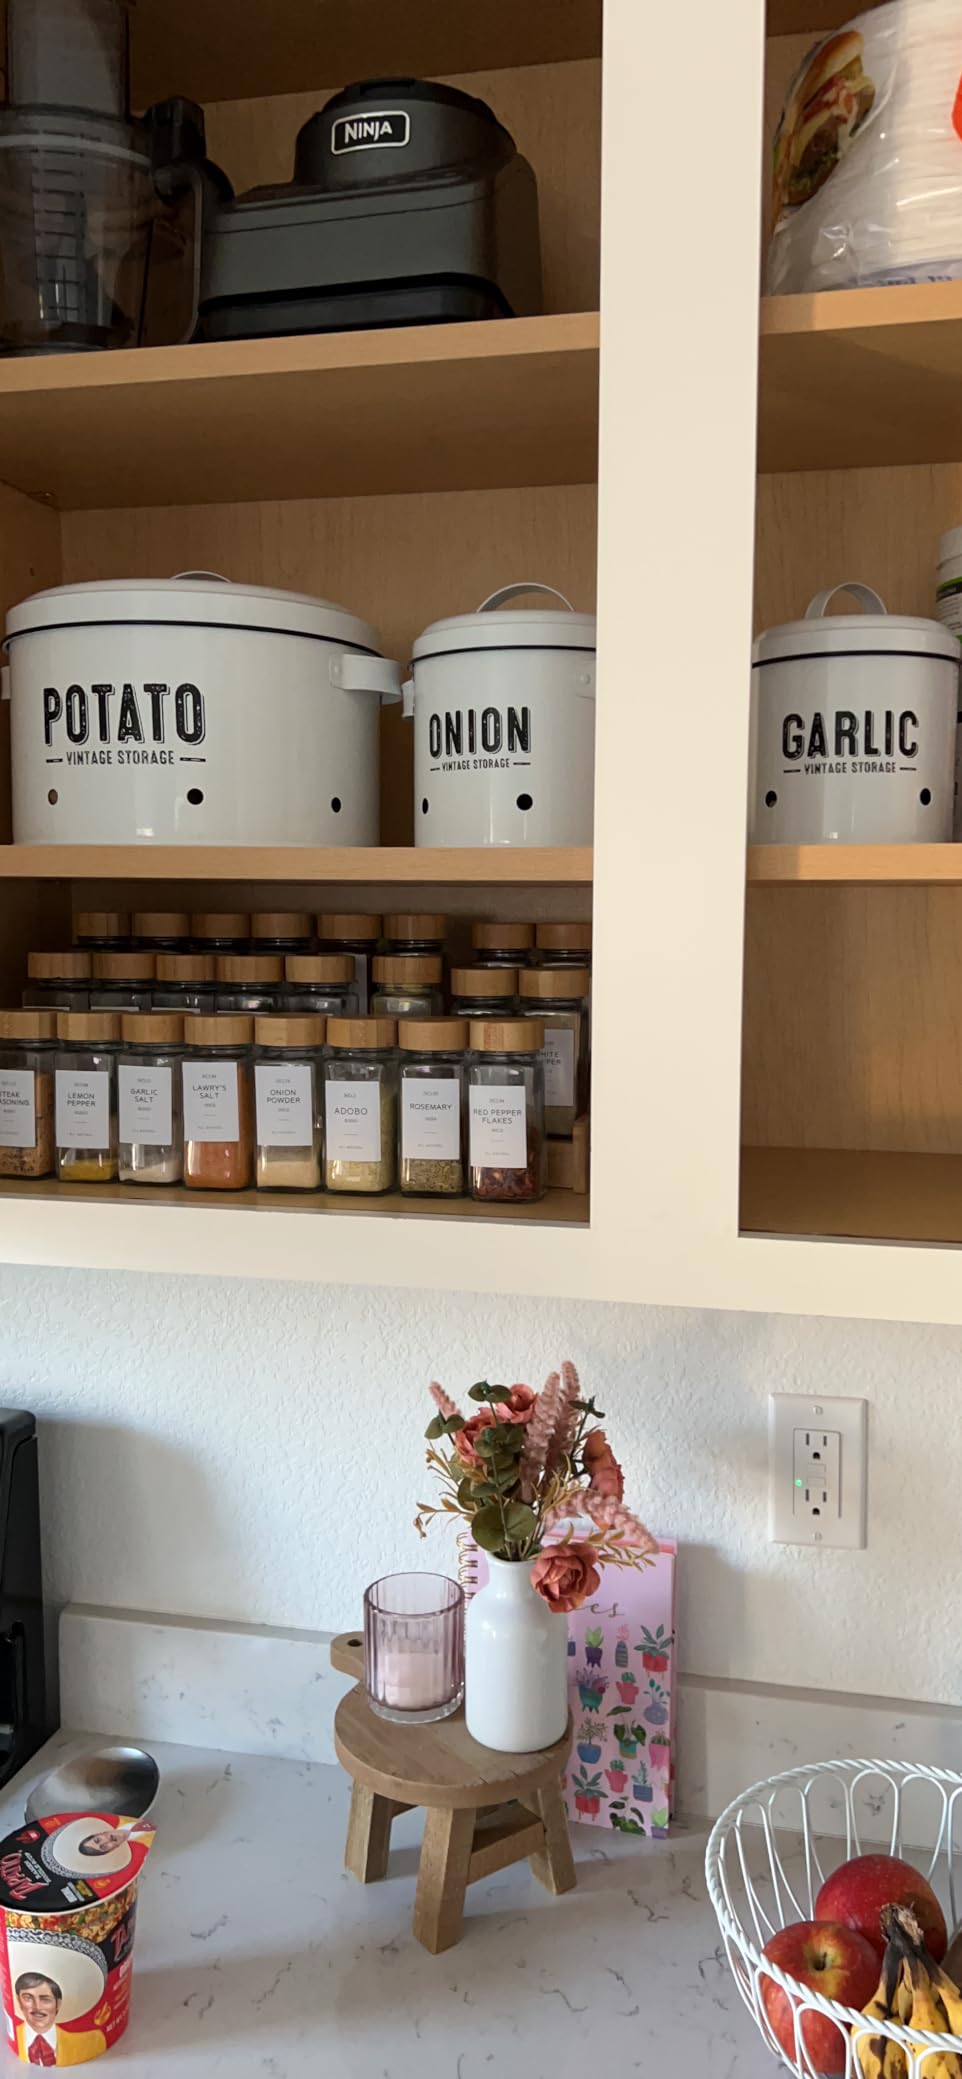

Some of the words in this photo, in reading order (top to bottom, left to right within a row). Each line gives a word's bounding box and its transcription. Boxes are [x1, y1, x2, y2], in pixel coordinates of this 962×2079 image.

[344, 121, 393, 144] NINJA
[43, 683, 206, 746] POTATO
[429, 706, 531, 760] ONION
[782, 710, 919, 760] GARLIC
[66, 751, 113, 766] VINTAGE
[117, 750, 175, 765] STORAGE
[441, 760, 471, 773] VINTAGE
[473, 758, 511, 770] STORAGE
[804, 762, 847, 775] VINTAGE
[851, 761, 897, 773] STORAGE
[130, 1088, 158, 1096] GARLIC
[192, 1084, 227, 1092] LAWRY'S
[67, 1092, 95, 1100] LEMON
[199, 1092, 220, 1100] SALT
[270, 1089, 296, 1097] ONION
[0, 1098, 30, 1106] SONING
[134, 1095, 154, 1103] SALT
[266, 1096, 301, 1104] POWDER
[66, 1100, 96, 1108] PEPPER
[409, 1103, 453, 1111] ROSEMARY
[334, 1107, 368, 1116] ADOBO
[473, 1108, 489, 1116] RED
[491, 1108, 522, 1117] PEPPER
[481, 1117, 513, 1125] FLAKES
